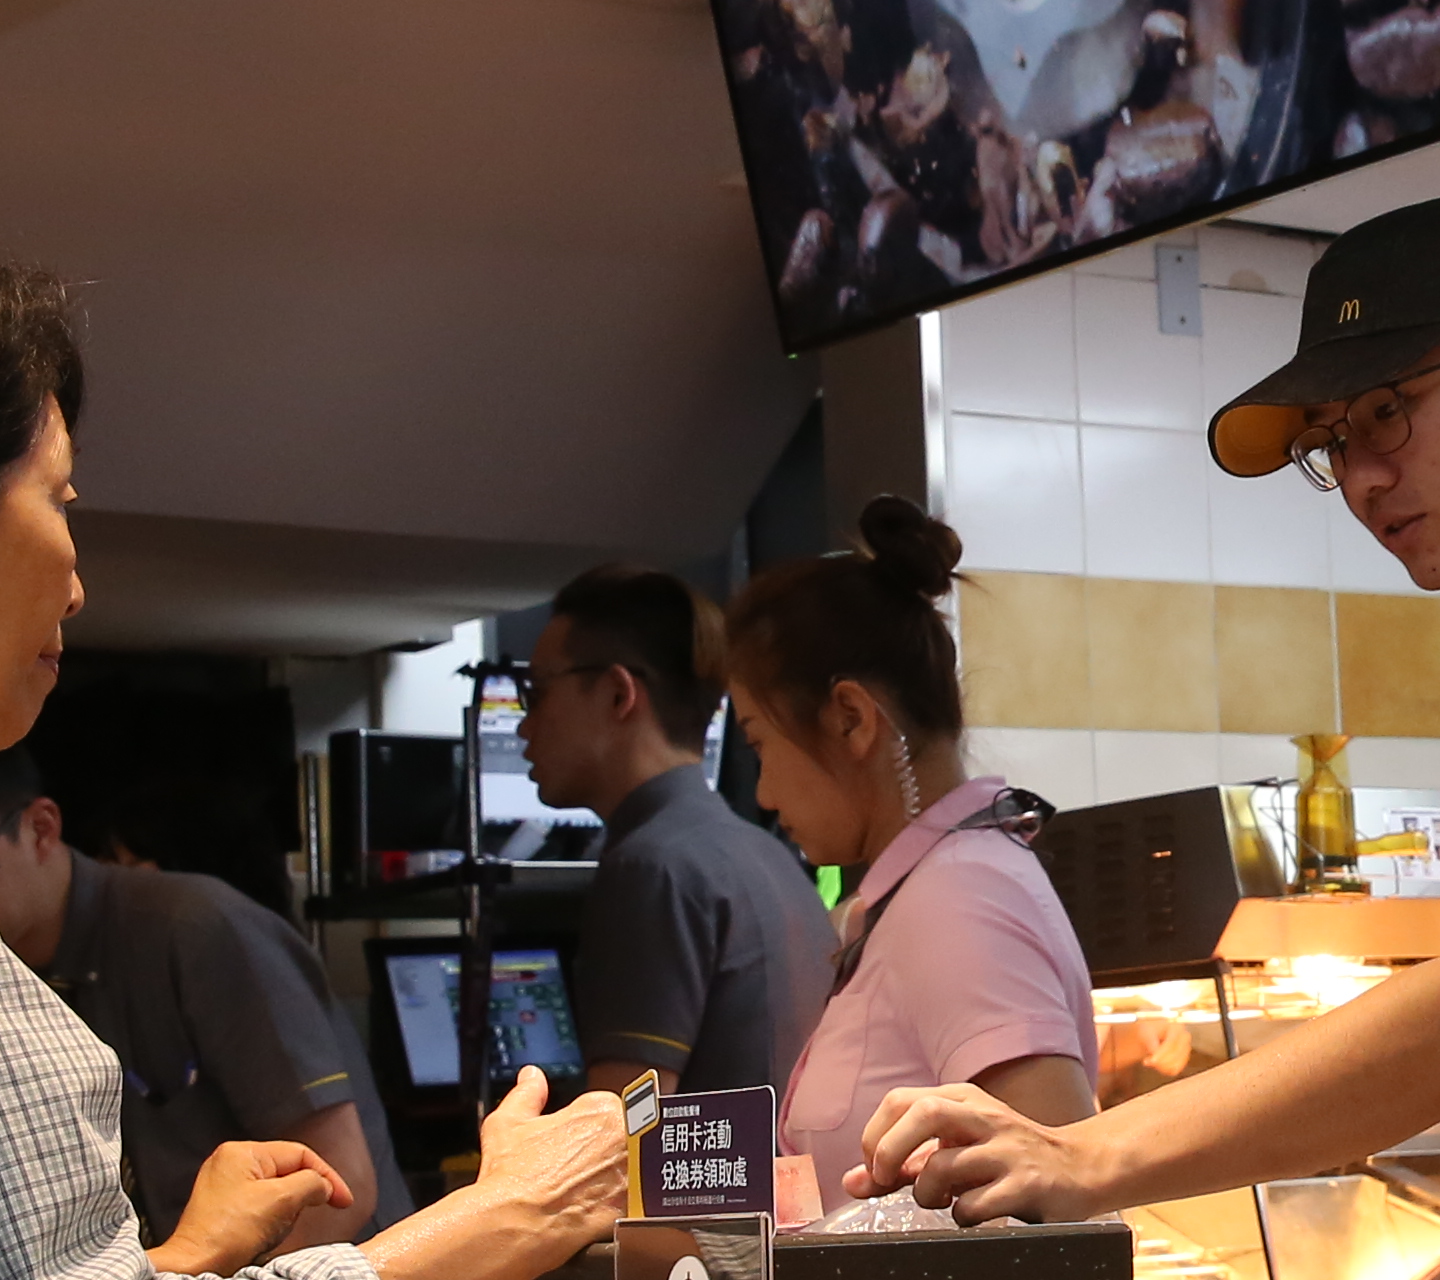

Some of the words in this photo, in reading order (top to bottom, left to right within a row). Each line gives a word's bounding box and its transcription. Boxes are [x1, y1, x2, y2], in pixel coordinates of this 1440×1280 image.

[661, 1119, 732, 1154] 信用卡活動
[661, 1156, 747, 1191] 兌換券領取處
